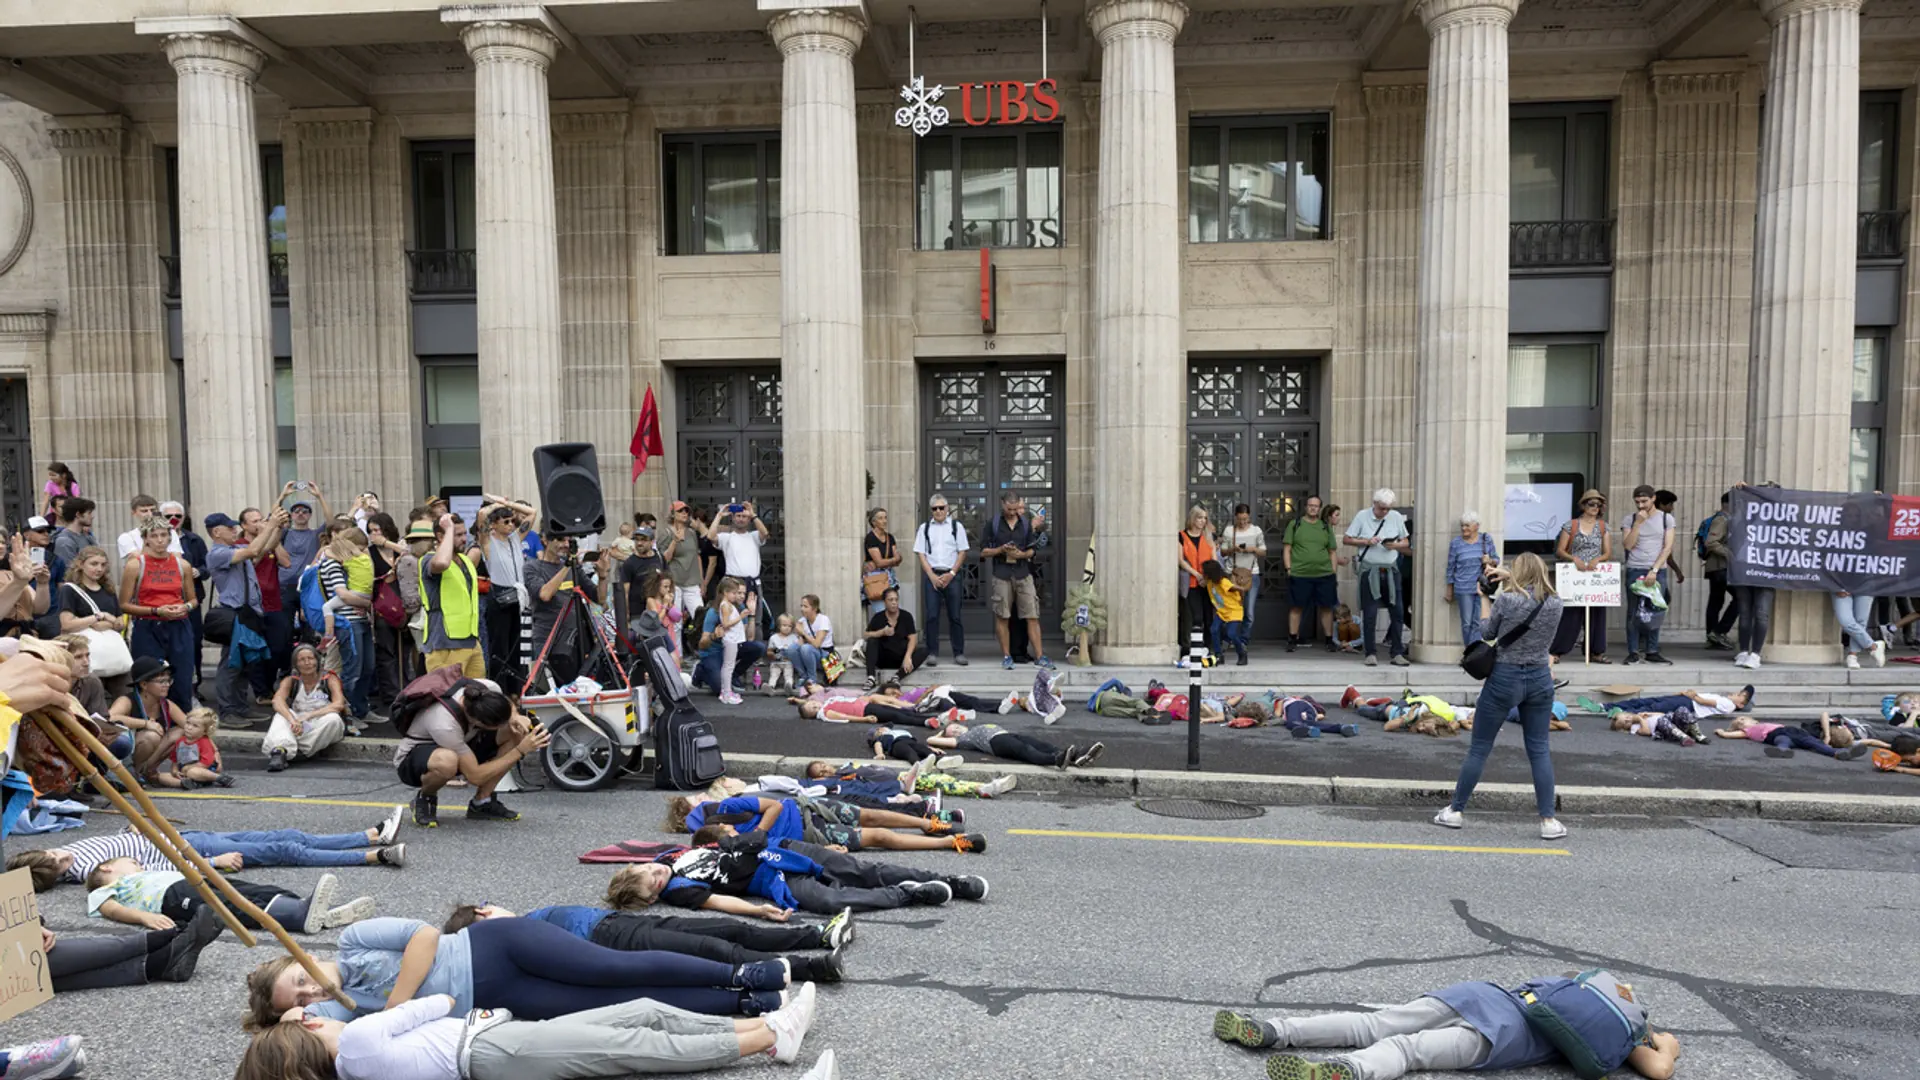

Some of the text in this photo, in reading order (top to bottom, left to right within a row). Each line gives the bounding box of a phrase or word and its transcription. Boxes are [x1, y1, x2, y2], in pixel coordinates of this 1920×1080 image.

[960, 78, 1060, 126] UBS
[984, 340, 996, 350] 16
[1746, 502, 1843, 525] POUR UNE
[1894, 509, 1920, 527] 25
[1746, 525, 1867, 550] SUISSE SANS
[1893, 527, 1920, 536] SEPT.
[1747, 543, 1906, 576] ÉLEVAGE INTENSIF
